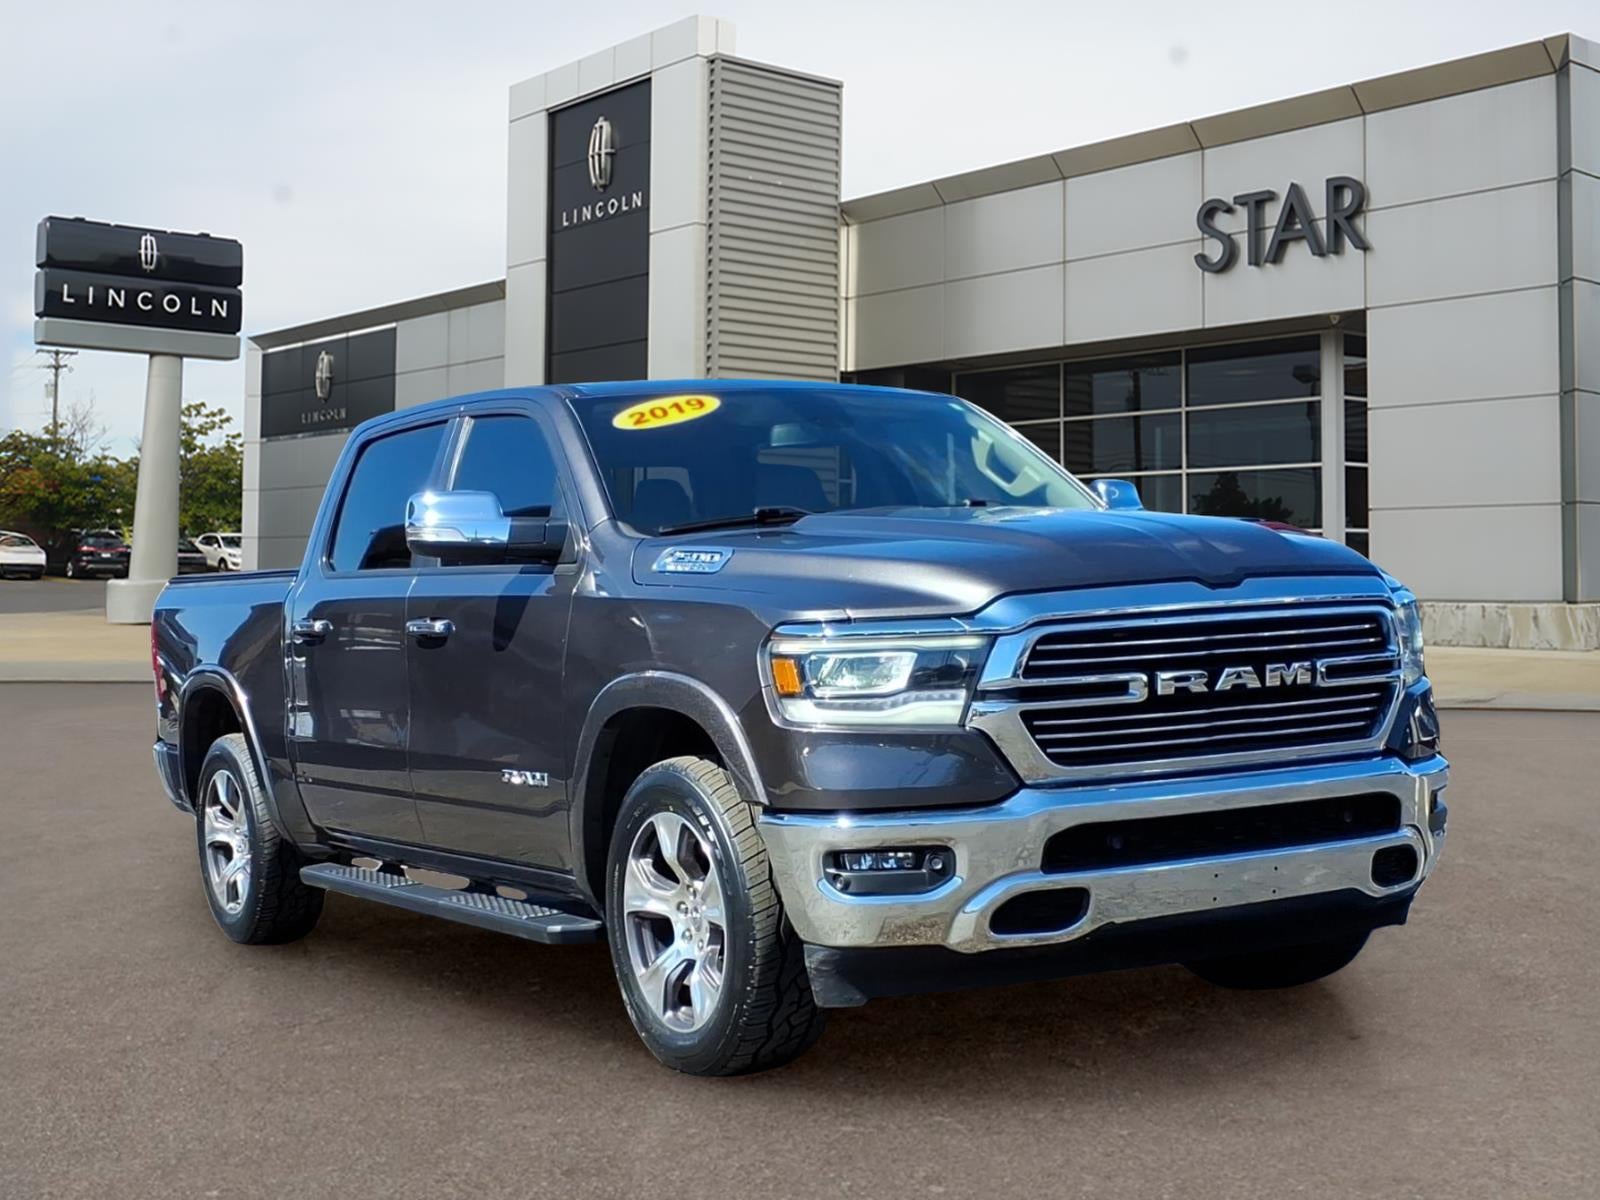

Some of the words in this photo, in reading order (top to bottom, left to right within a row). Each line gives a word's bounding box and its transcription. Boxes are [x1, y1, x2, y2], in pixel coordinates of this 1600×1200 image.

[562, 191, 643, 227] LINCOLN
[1194, 176, 1371, 273] STAR
[62, 283, 229, 319] LINCOLN
[301, 407, 347, 424] LINCOLN
[628, 398, 705, 426] 2019
[1156, 660, 1312, 696] RAM
